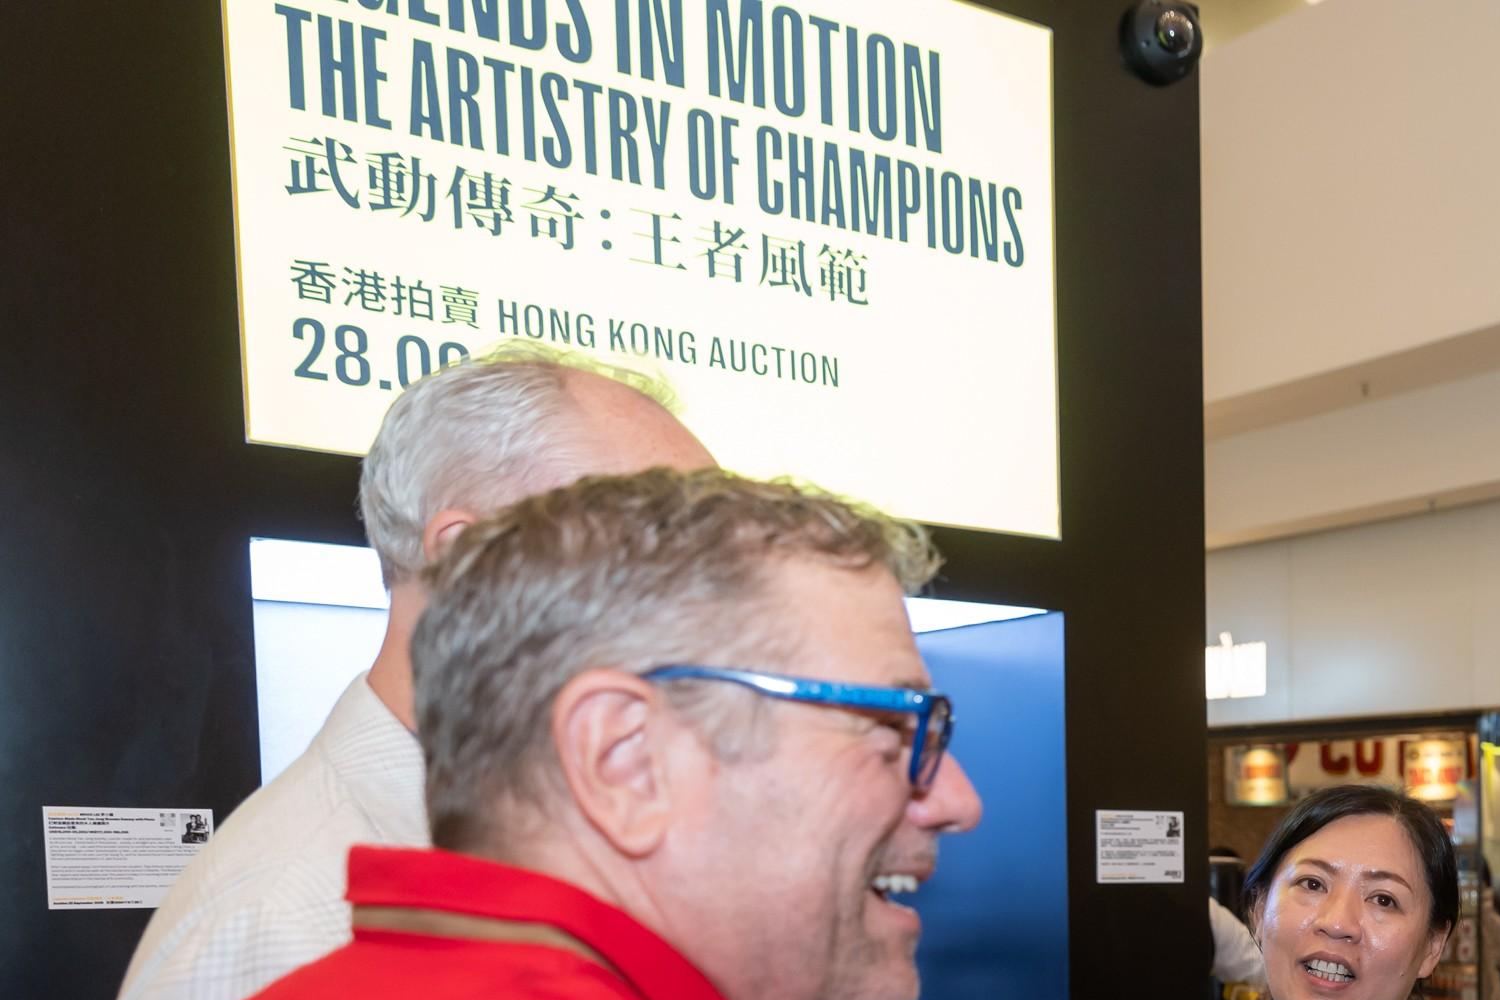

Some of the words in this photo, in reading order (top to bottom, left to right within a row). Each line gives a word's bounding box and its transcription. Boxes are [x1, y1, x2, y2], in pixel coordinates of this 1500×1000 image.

[275, 3, 393, 131] THE
[410, 38, 671, 191] ARTISTRY
[687, 108, 740, 205] OF
[757, 125, 1024, 268] CHAMPIONS
[612, 0, 685, 89] IN
[707, 0, 942, 154] MOTION
[290, 259, 480, 329] 香港拍賣
[498, 299, 596, 349] HONG
[609, 318, 697, 365] KONG
[709, 336, 839, 388] AUCTION
